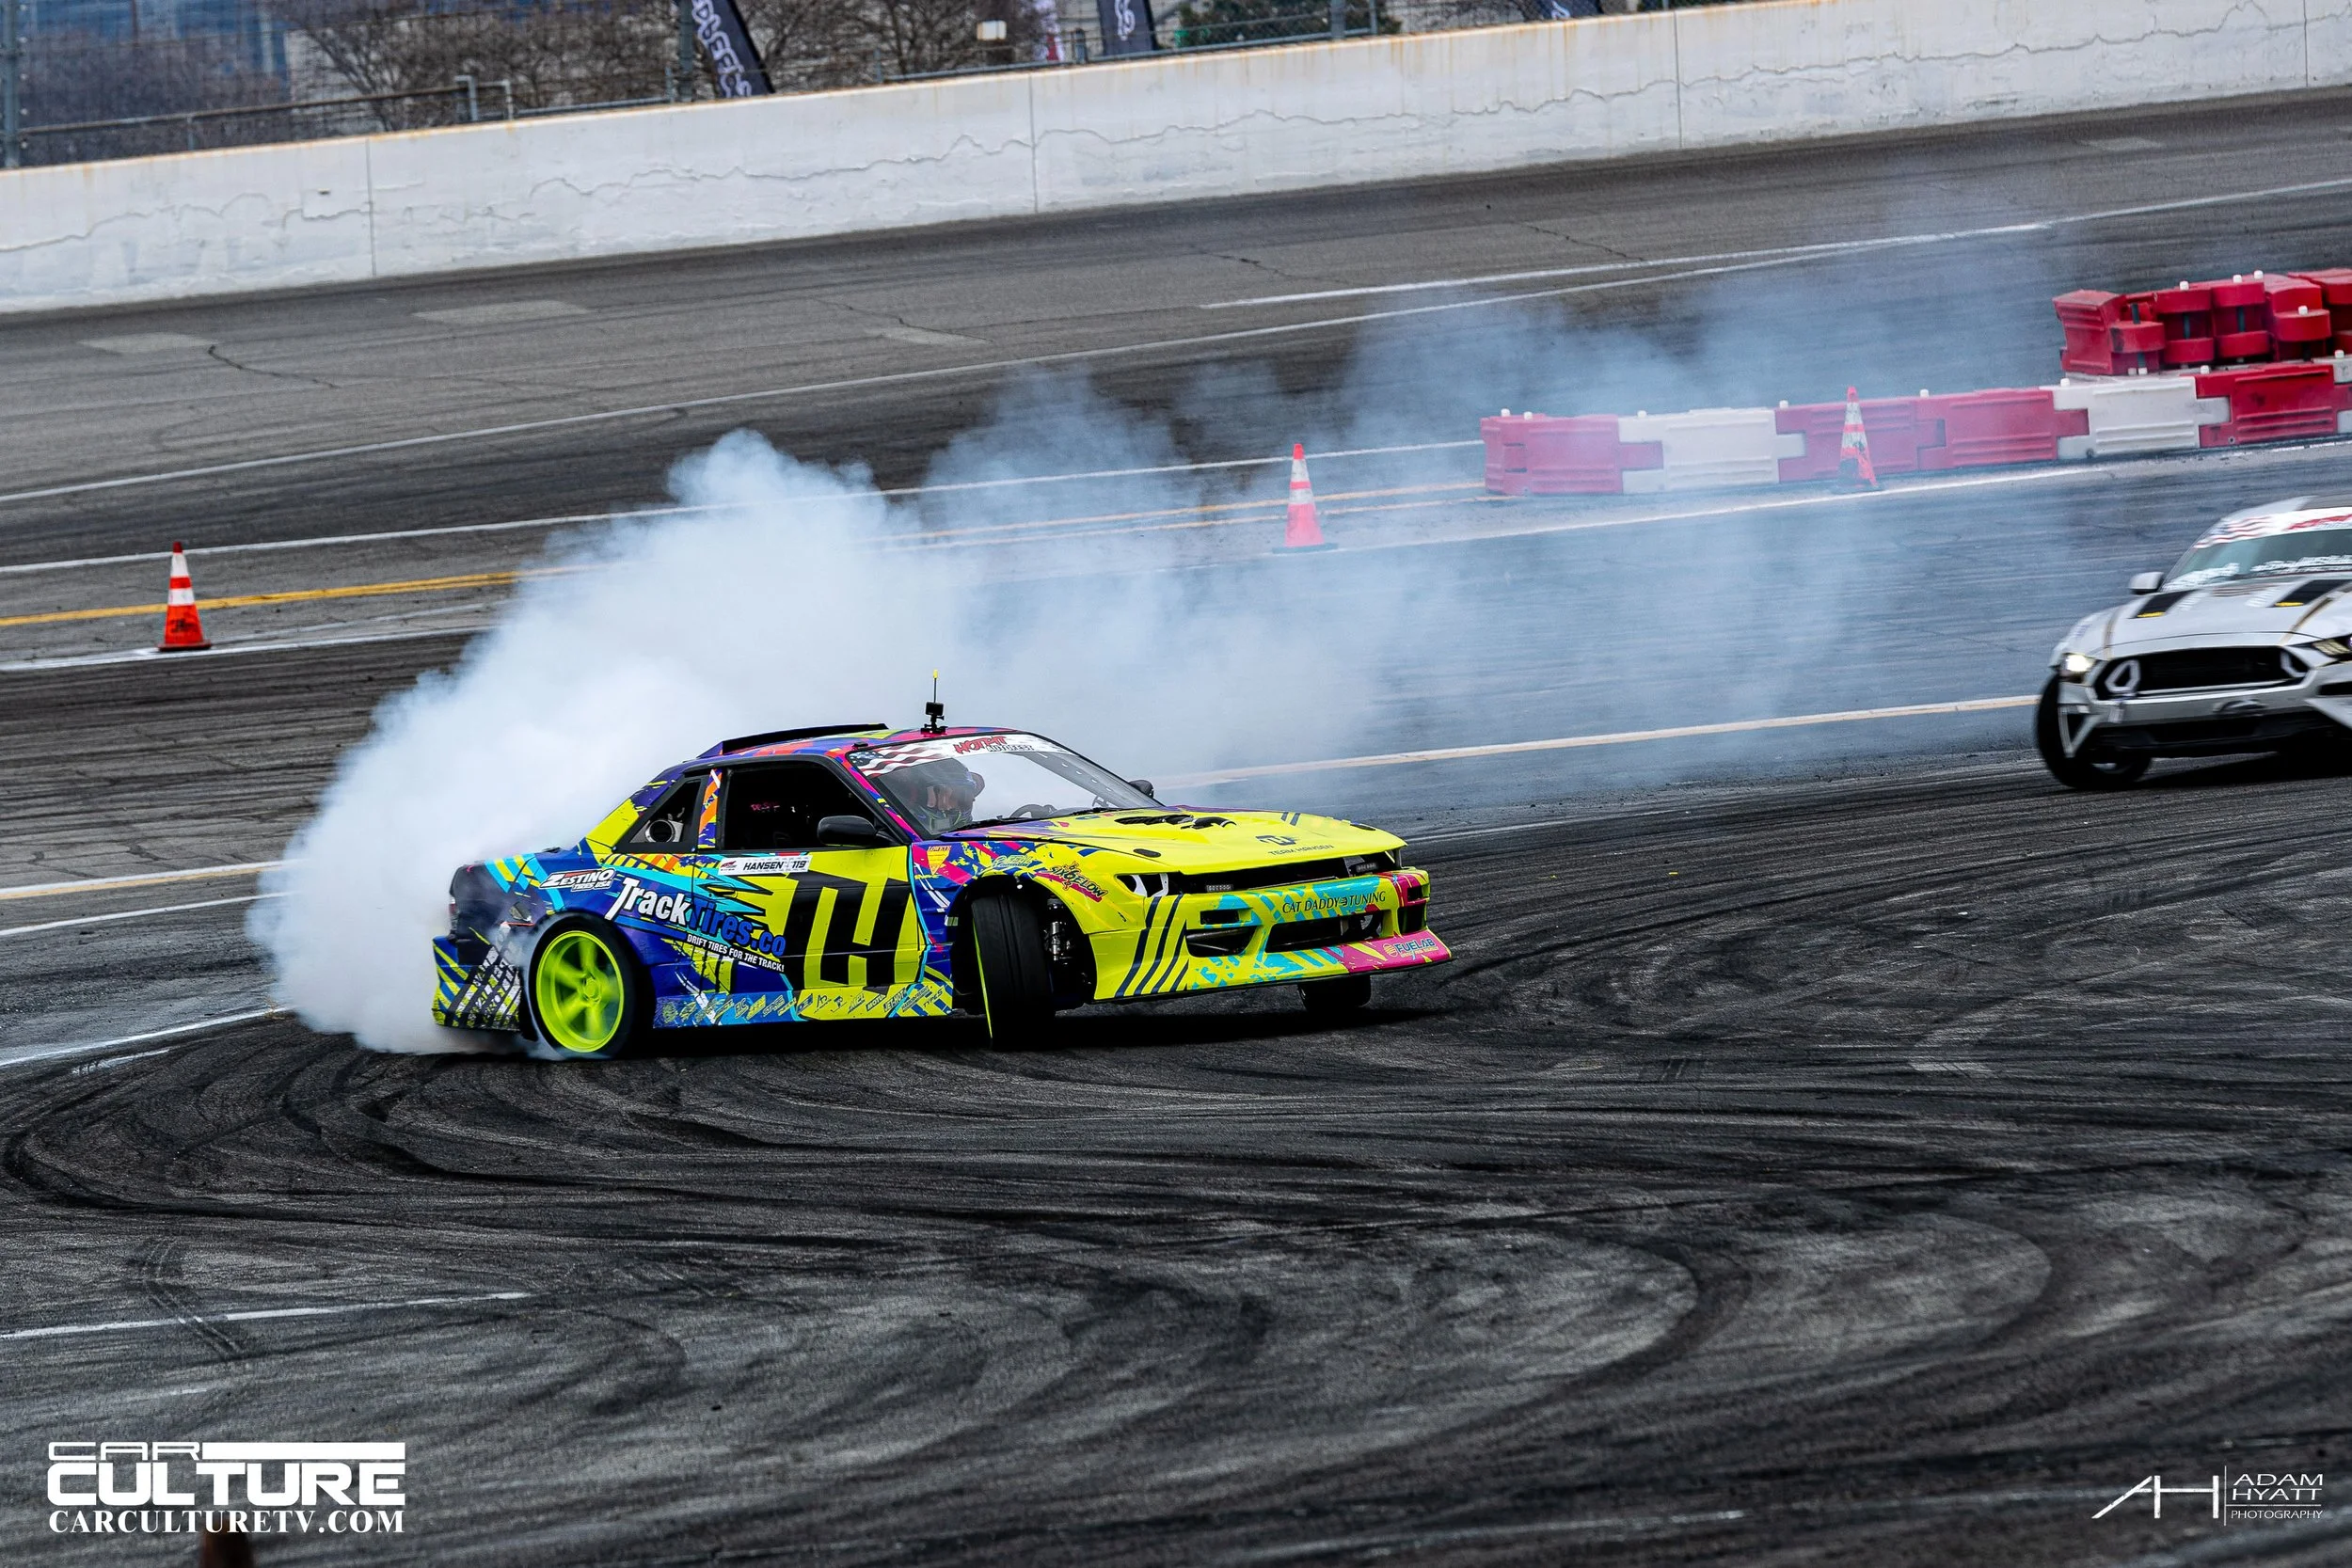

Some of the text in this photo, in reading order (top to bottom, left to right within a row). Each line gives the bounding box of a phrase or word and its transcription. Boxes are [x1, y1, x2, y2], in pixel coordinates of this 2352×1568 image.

[742, 861, 785, 871] HANSEN
[791, 860, 807, 869] 119
[539, 868, 615, 889] ZESTINO
[1282, 891, 1386, 914] CAT DADDY TUNING
[686, 933, 786, 973] DRIFT TIRES FOR THE TRACK!
[1393, 938, 1437, 954] FUELAB
